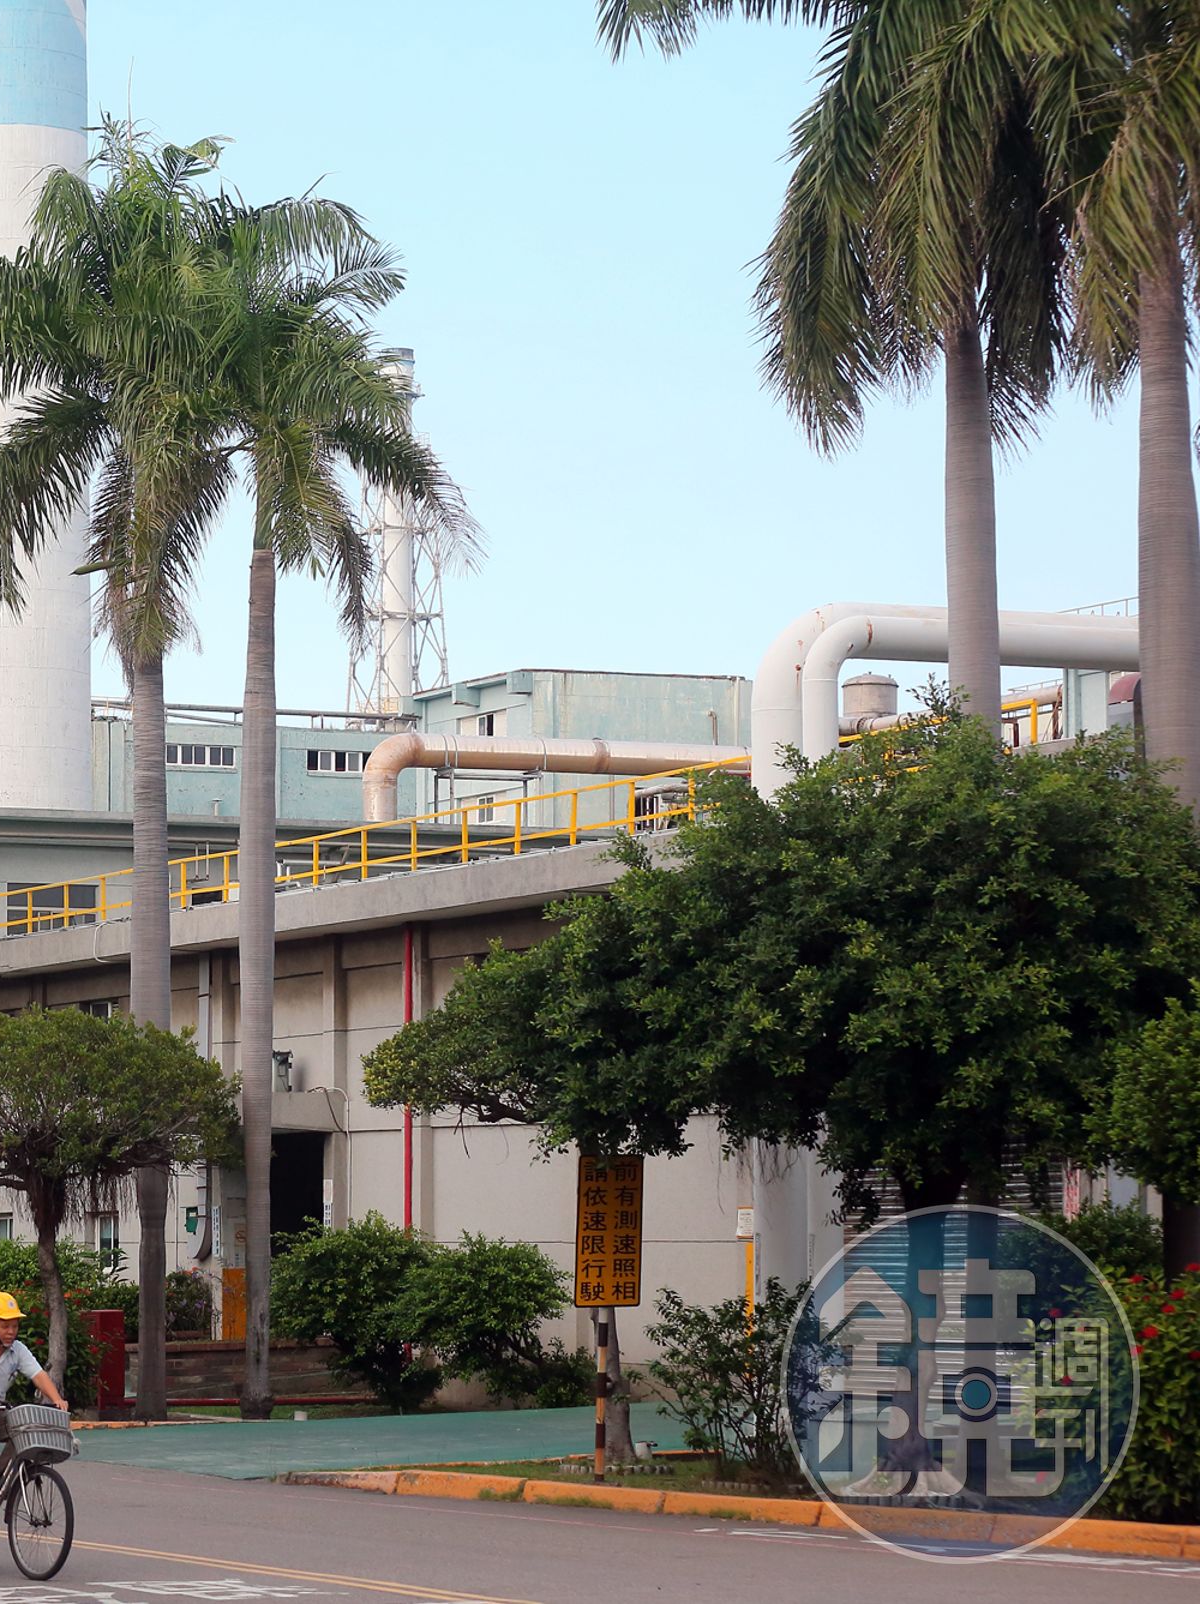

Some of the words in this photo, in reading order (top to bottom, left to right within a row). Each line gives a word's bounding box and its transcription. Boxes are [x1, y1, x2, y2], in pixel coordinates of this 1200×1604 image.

[580, 1161, 608, 1301] 請依速限行駛
[611, 1161, 639, 1300] 前有測速照相
